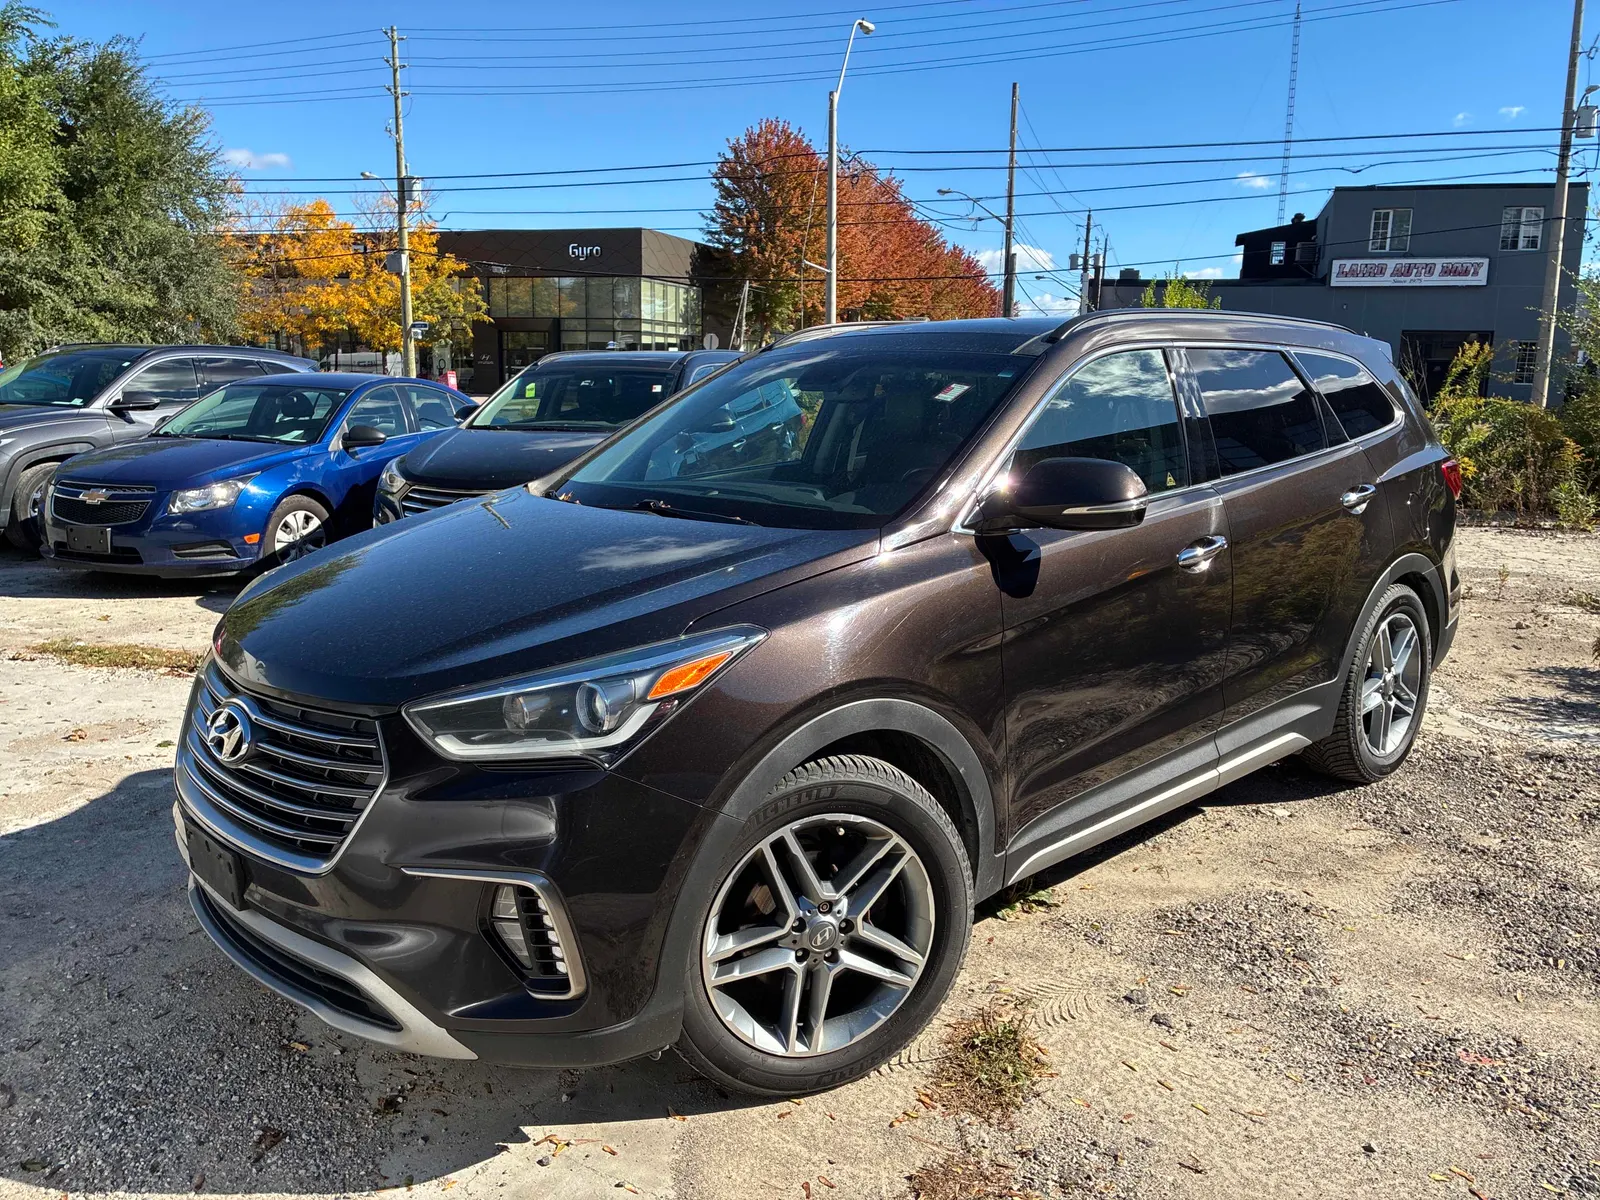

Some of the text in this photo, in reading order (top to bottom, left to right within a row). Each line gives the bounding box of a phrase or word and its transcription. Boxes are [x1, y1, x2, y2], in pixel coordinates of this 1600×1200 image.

[569, 243, 601, 260] Gyro
[1336, 262, 1484, 278] LAIRD AUTO BODY
